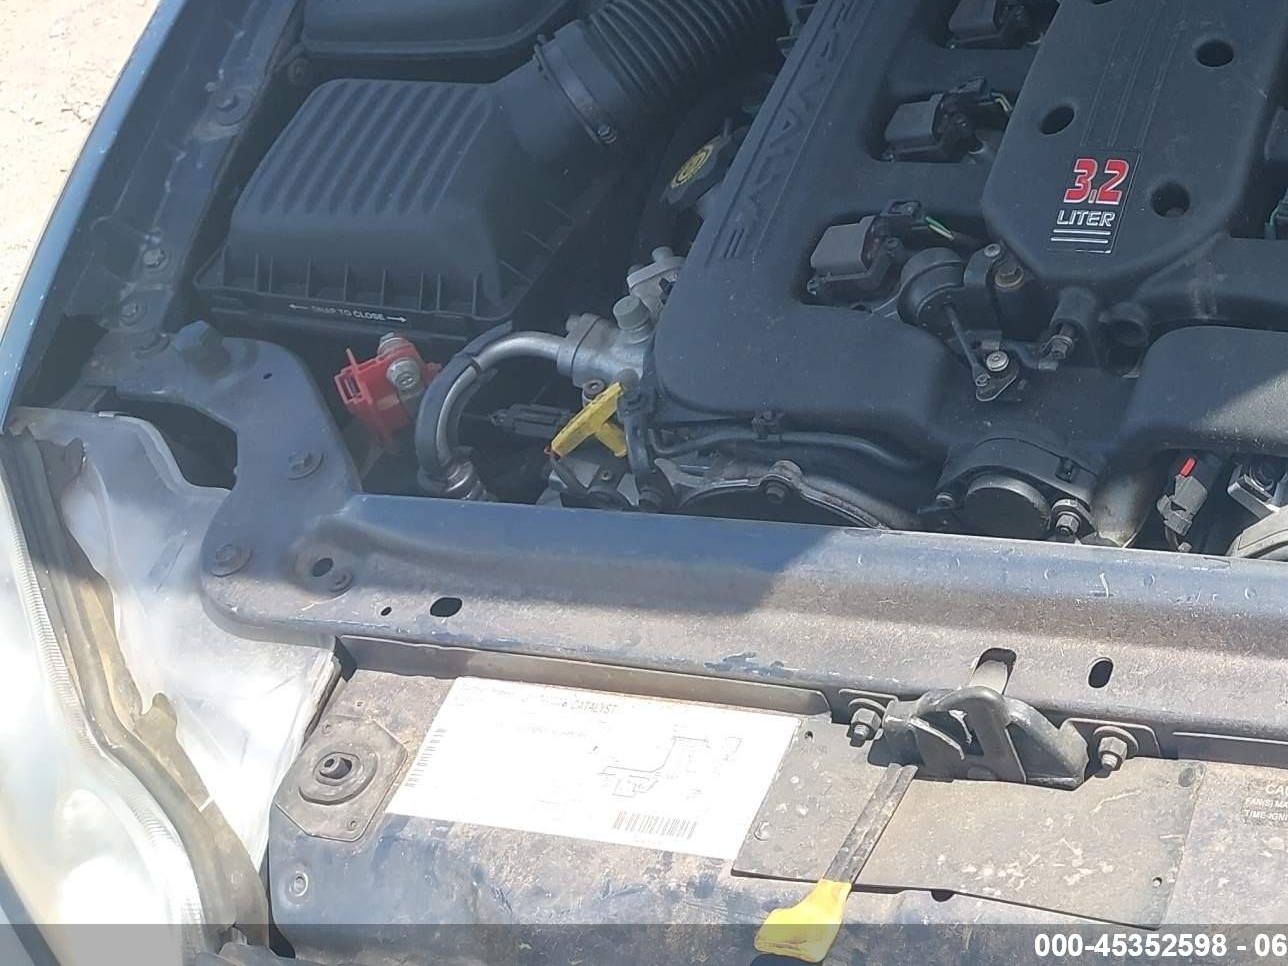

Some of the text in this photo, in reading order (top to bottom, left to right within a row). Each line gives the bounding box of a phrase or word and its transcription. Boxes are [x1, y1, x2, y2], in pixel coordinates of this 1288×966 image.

[1063, 158, 1130, 205] 3.2
[1056, 209, 1116, 227] LITER
[353, 310, 386, 321] CLOSE
[570, 700, 618, 714] CATALYST
[1245, 797, 1274, 808] FAN(S)
[1243, 809, 1266, 819] TIME
